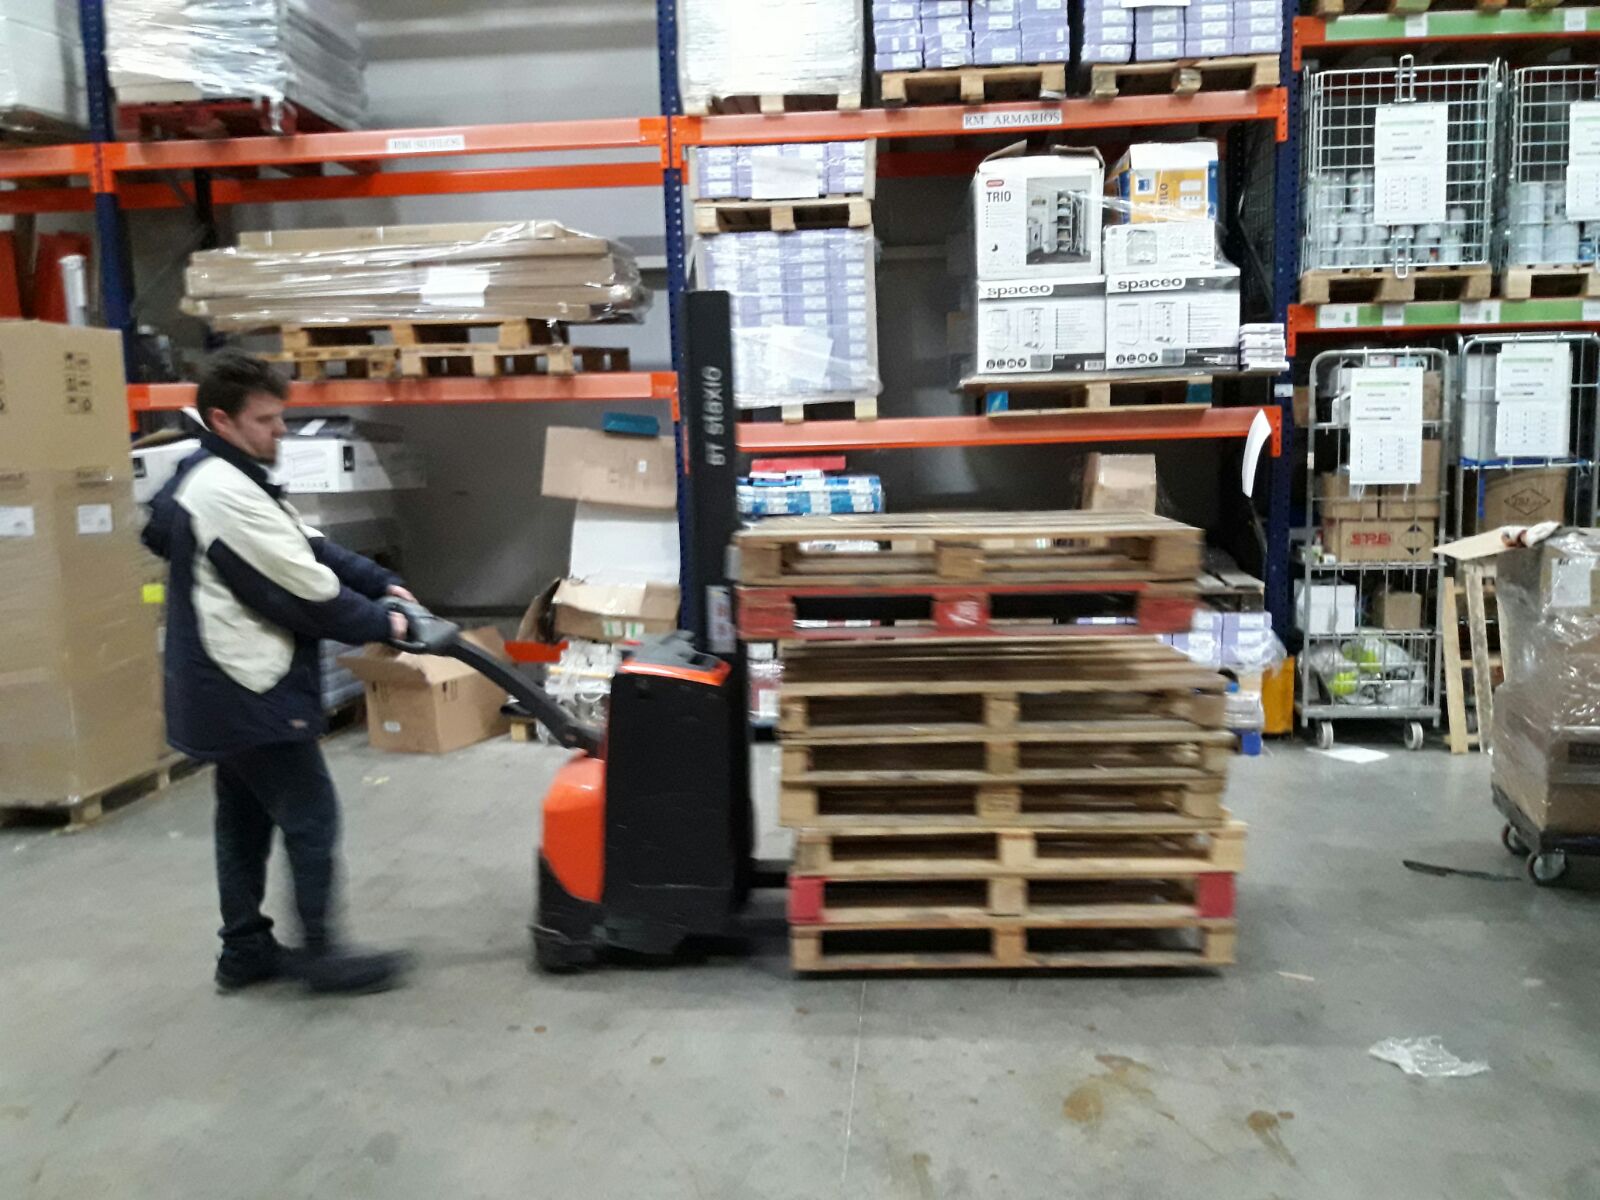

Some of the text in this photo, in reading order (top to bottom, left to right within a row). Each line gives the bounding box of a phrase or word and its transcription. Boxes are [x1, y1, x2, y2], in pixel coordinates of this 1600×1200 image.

[965, 111, 1060, 127] RM ARMARIOS
[986, 190, 1011, 203] TRIO
[986, 283, 1050, 299] spaceo
[1117, 277, 1182, 292] spaceo
[704, 442, 726, 466] BT
